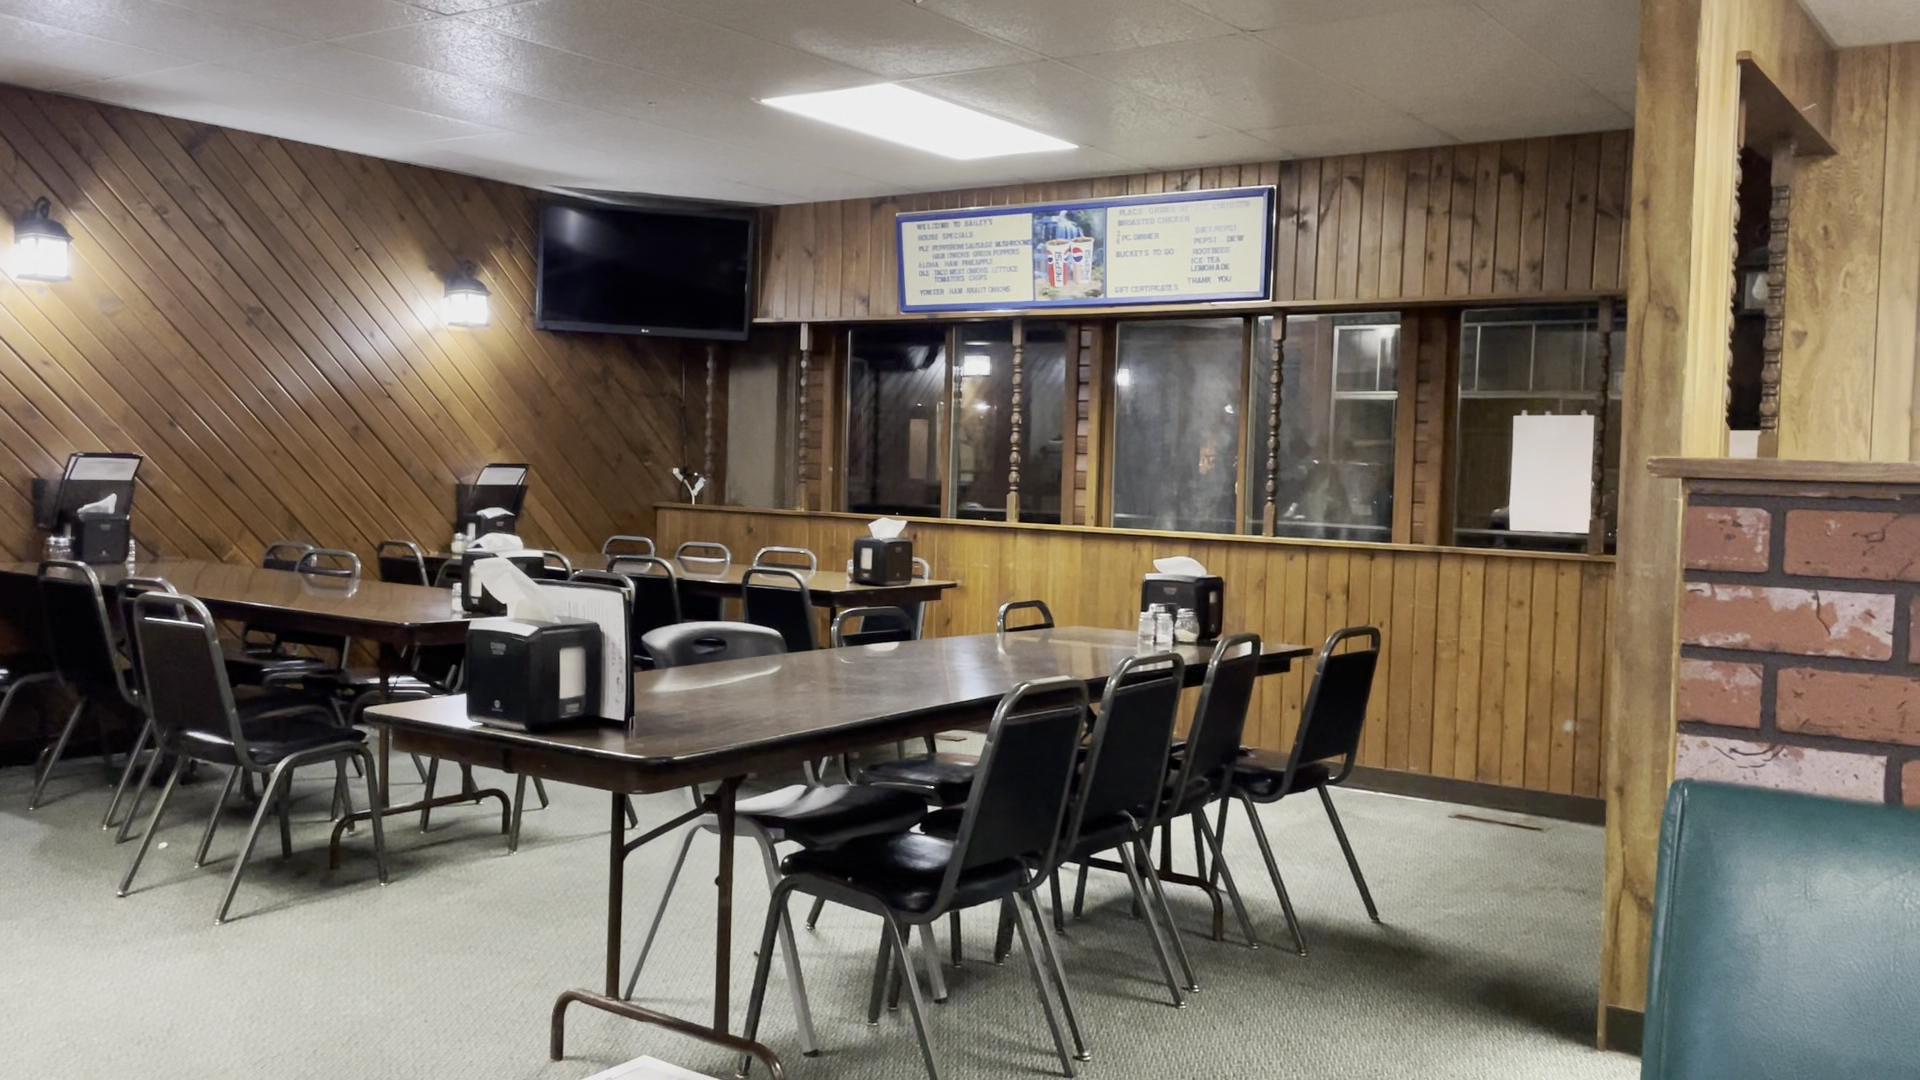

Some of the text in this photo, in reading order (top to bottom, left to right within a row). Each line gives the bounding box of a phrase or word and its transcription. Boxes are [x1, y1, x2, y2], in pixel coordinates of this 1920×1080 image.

[1157, 216, 1190, 225] CHICKEN
[917, 222, 949, 231] WELCOME
[1116, 249, 1150, 258] BUCKETS
[1187, 275, 1232, 285] THANK YOU
